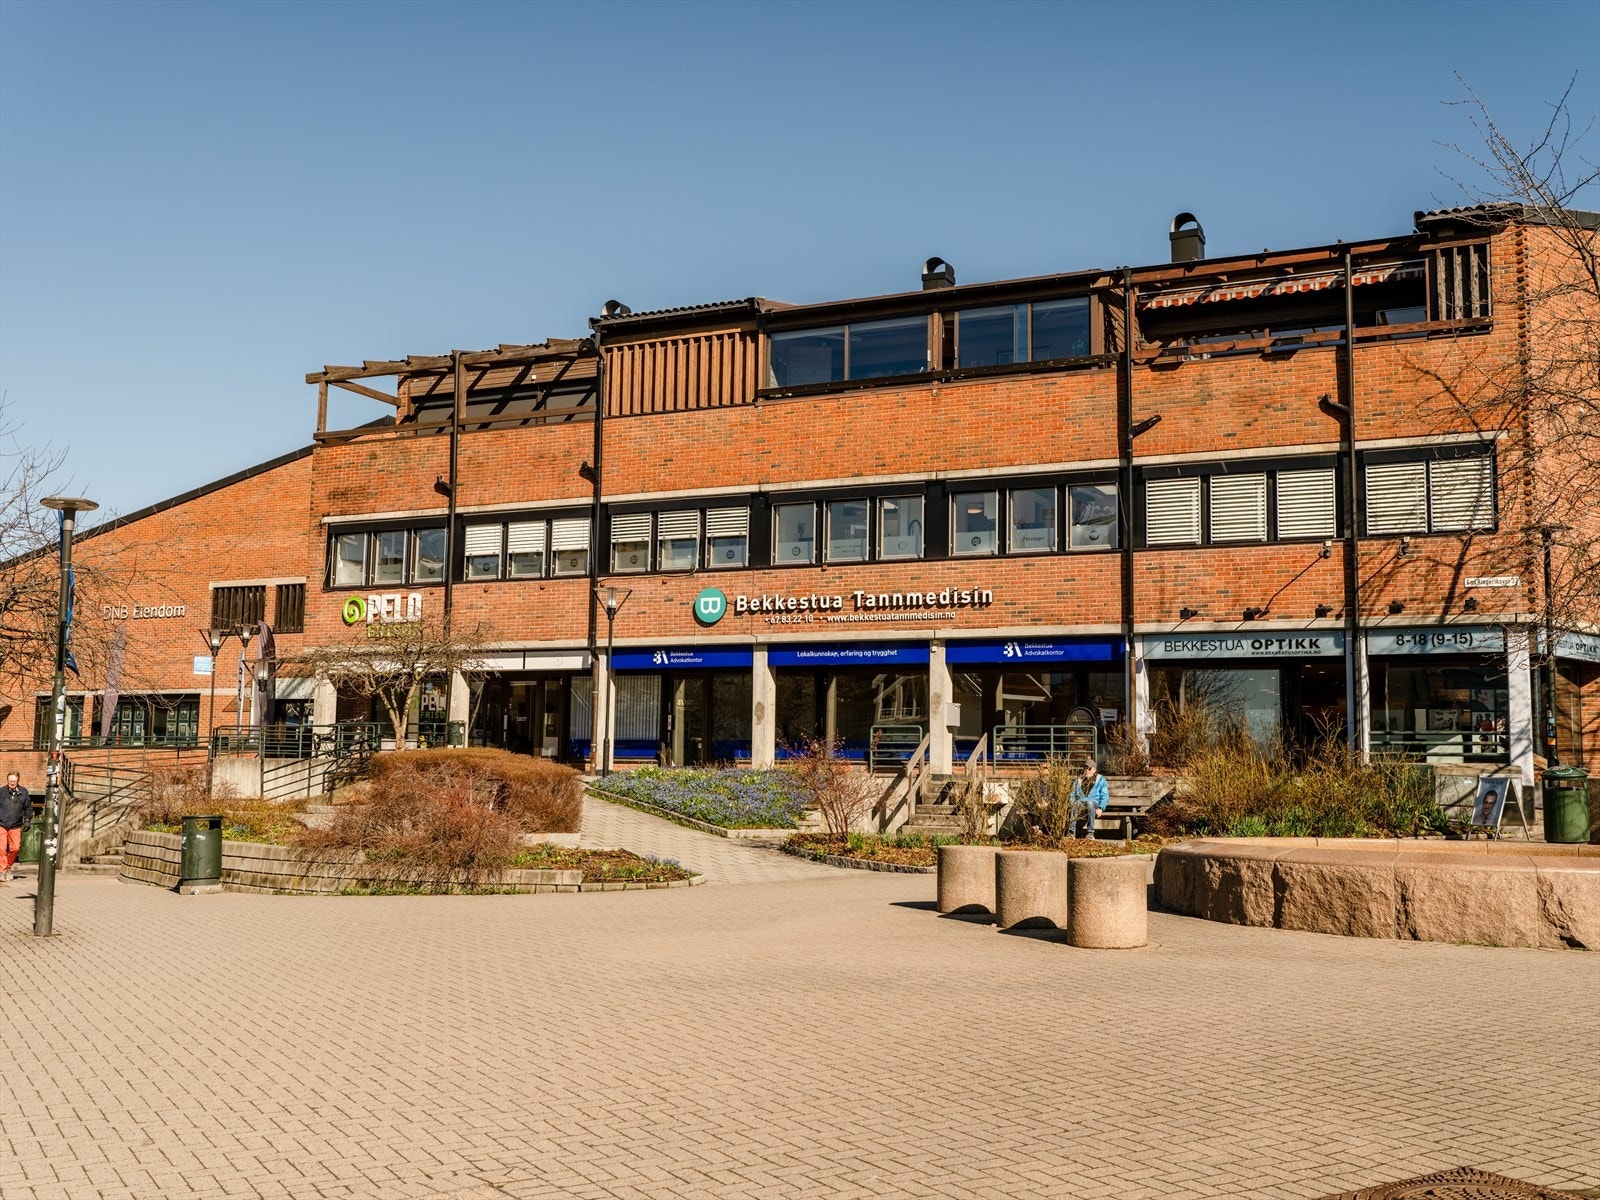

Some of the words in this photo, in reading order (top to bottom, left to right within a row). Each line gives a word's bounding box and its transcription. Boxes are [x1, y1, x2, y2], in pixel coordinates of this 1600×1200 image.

[736, 594, 843, 612] Bekkestua
[853, 586, 993, 609] Tannmedisin
[103, 605, 129, 620] DNB
[133, 603, 185, 619] Eiendom
[367, 592, 422, 623] PELO
[770, 615, 780, 624] 67
[782, 614, 791, 623] 83
[793, 614, 802, 623] 22
[804, 614, 814, 622] 10
[826, 610, 956, 623] www.bekkestuatannmedisin.no
[1164, 639, 1245, 652] BEKKESTUA
[1250, 638, 1321, 650] OPTIKK
[1396, 633, 1427, 646] 8-18
[1431, 632, 1473, 648] (9-15)
[872, 649, 898, 657] trygghet
